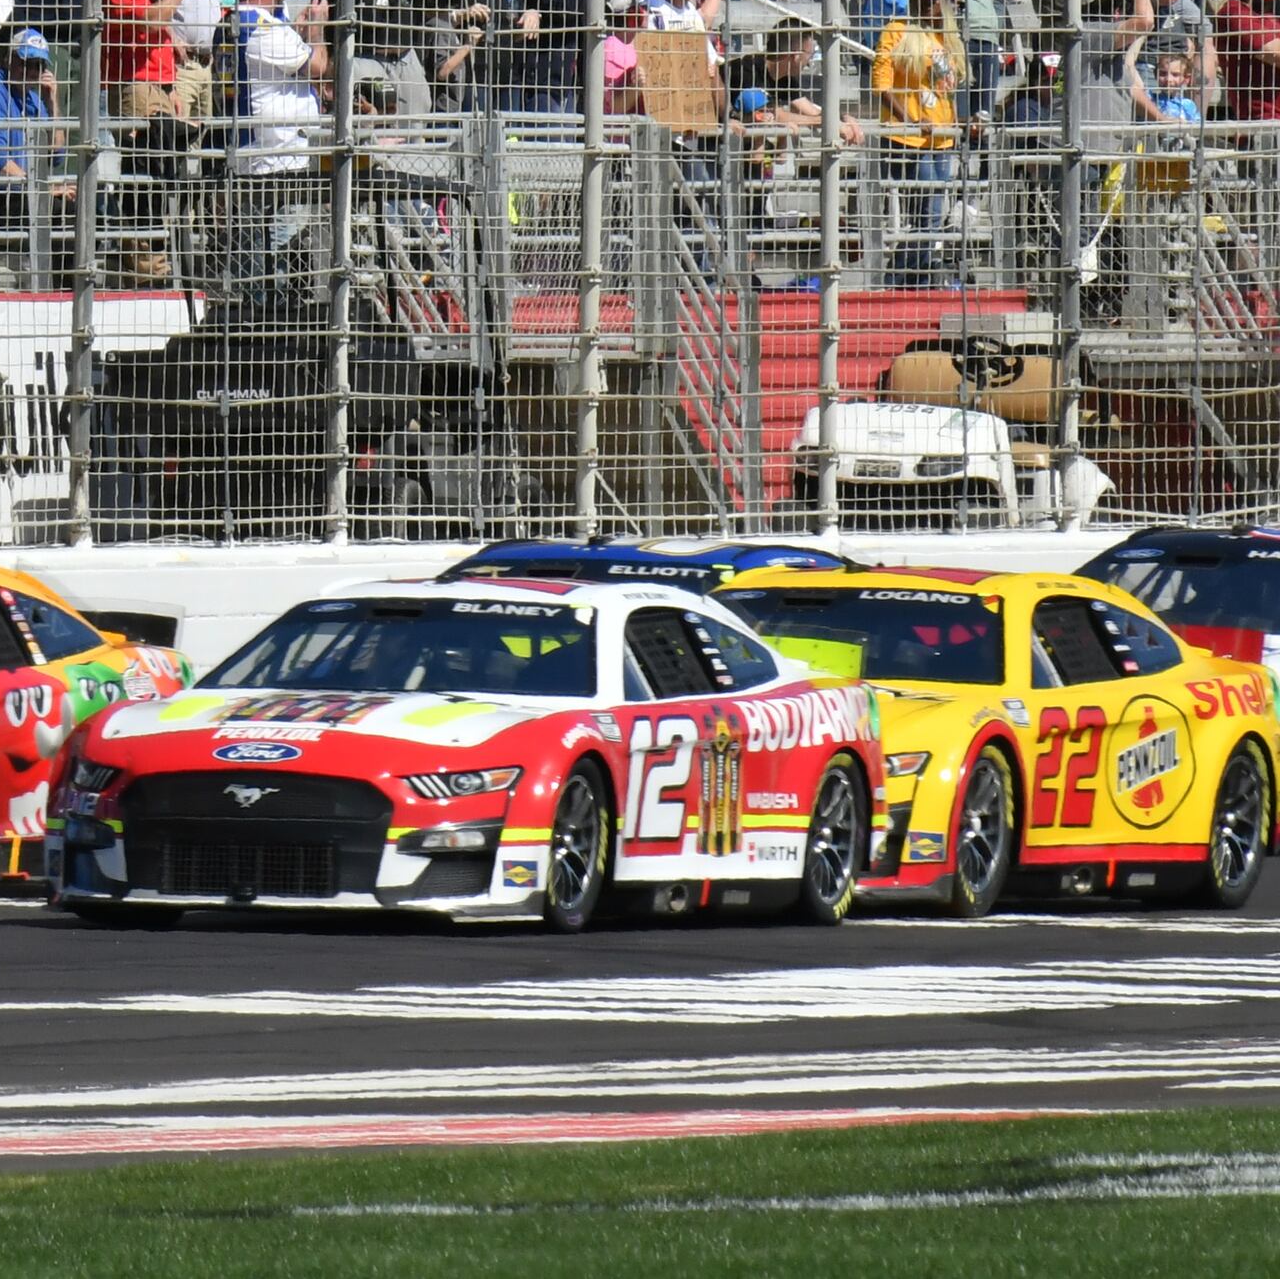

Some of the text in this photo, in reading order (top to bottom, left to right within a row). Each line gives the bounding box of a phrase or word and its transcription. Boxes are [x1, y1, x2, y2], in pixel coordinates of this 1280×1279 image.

[608, 564, 711, 579] ELLIOTT
[859, 589, 972, 605] LOGANO
[452, 601, 562, 618] BLANEY
[211, 727, 326, 742] PENNZOIL
[226, 743, 286, 759] Ford
[1032, 706, 1108, 827] 22
[624, 717, 699, 839] 12
